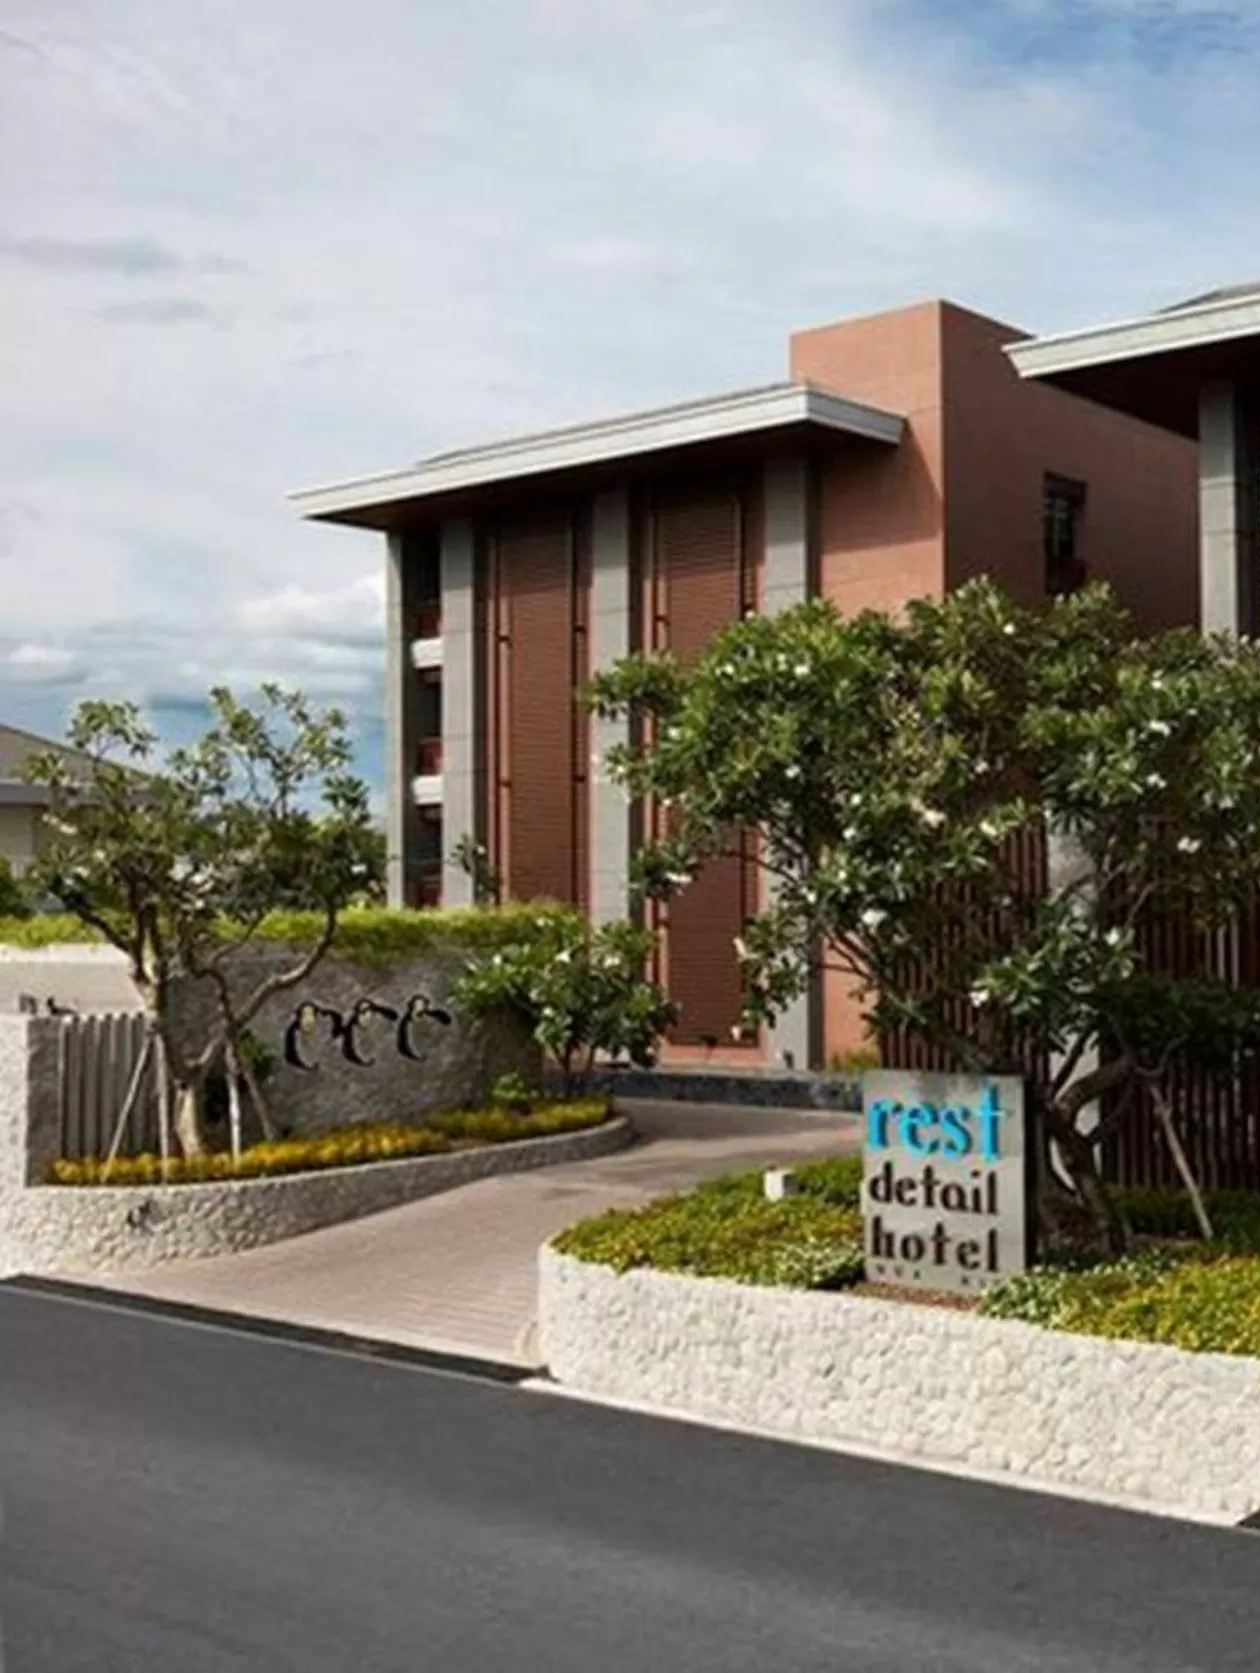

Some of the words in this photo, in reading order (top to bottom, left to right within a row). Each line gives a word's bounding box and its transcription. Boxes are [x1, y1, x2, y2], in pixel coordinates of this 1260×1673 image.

[867, 1083, 1004, 1164] rest
[868, 1161, 998, 1214] detail
[871, 1215, 998, 1273] hotel
